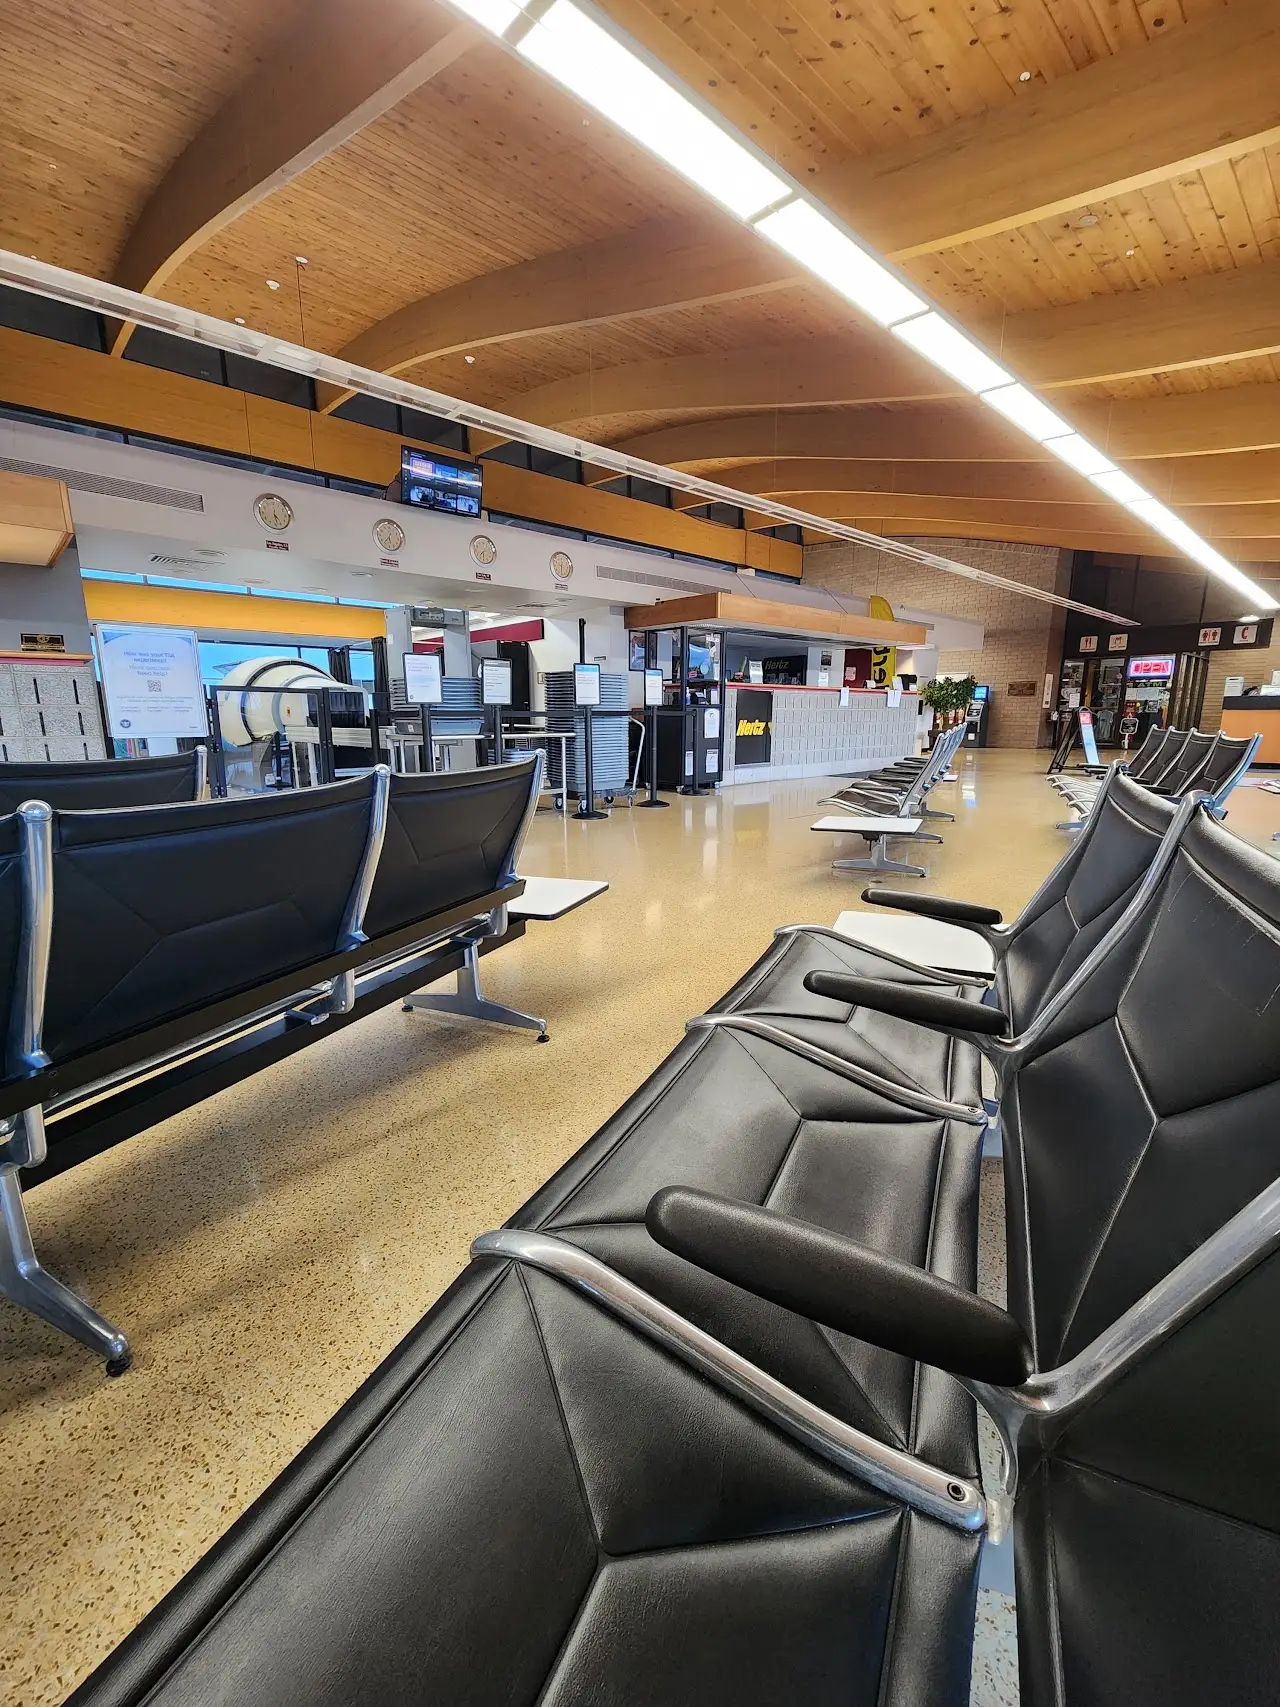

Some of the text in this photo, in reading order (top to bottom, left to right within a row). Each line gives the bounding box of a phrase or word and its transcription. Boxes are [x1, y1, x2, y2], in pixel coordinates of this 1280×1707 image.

[765, 660, 789, 670] Hertz
[1132, 661, 1169, 674] OPEN
[736, 719, 766, 736] Hertz
